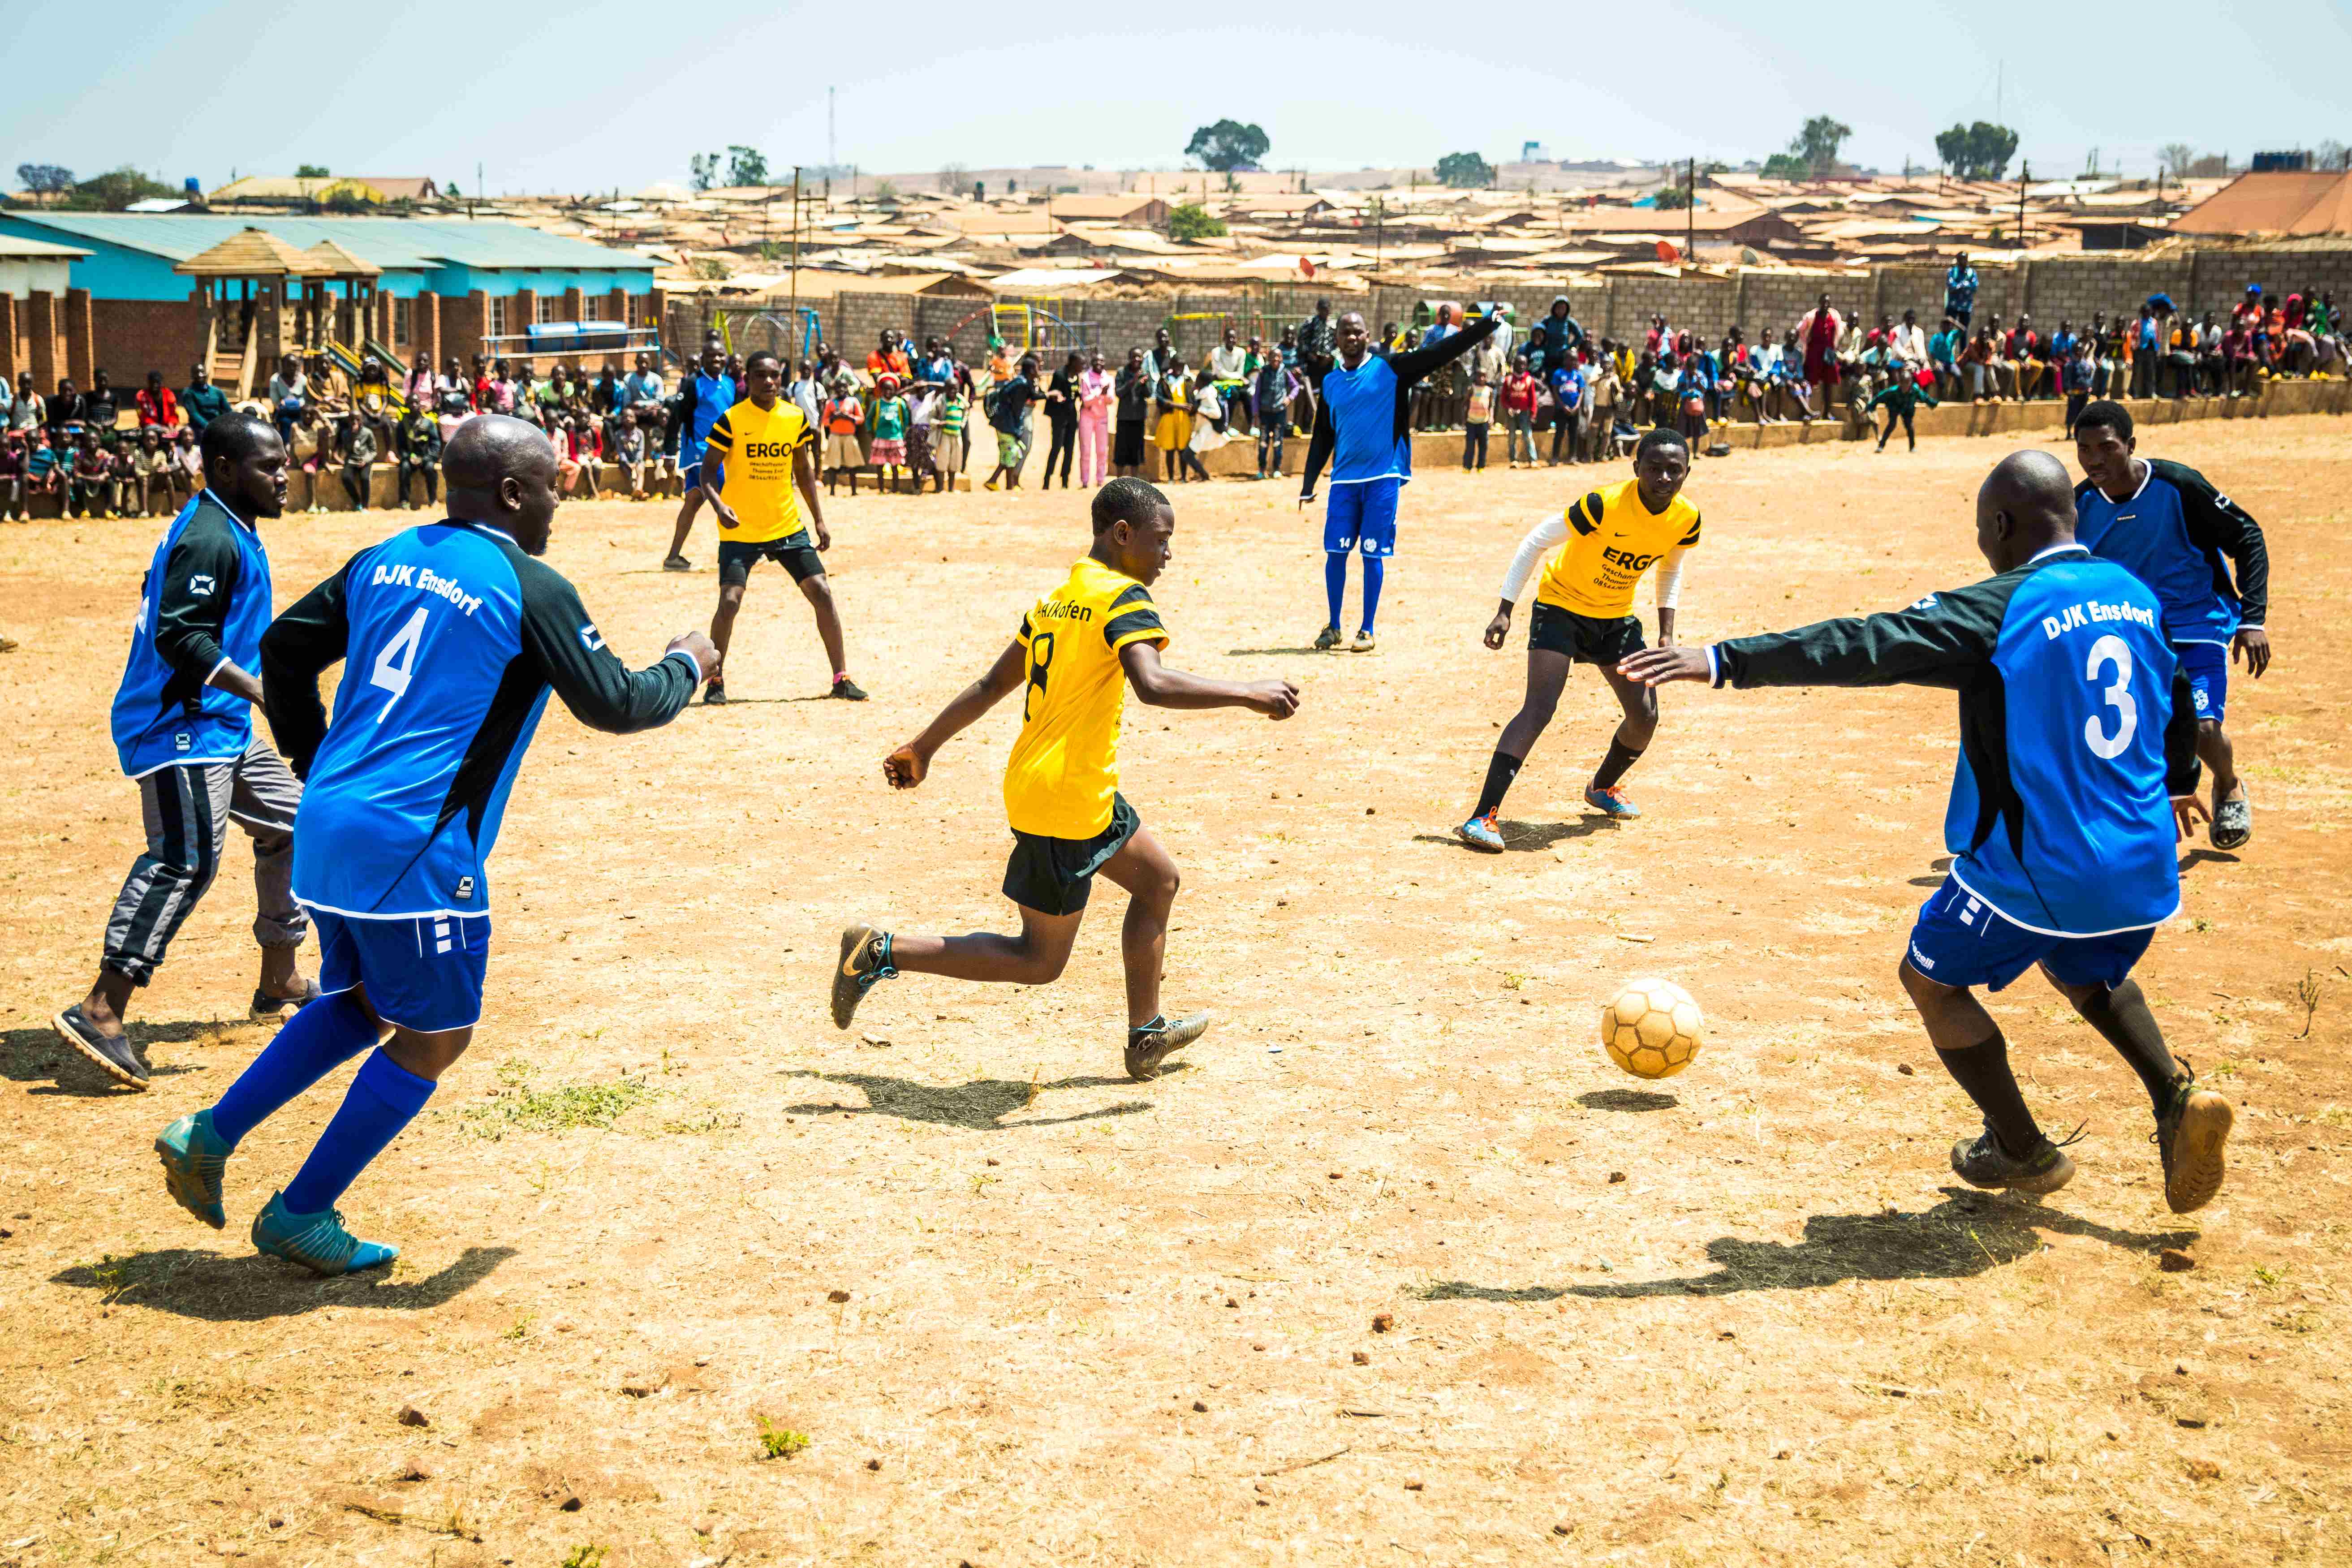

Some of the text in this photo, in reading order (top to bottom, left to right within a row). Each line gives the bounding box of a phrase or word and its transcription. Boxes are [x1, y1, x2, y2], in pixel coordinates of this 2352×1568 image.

[746, 443, 792, 457] ERGO
[1340, 537, 1350, 548] 14
[372, 564, 483, 617] DJK Ensdorf
[2042, 601, 2155, 641] DJK Ensdorf
[370, 607, 430, 724] 4
[1024, 632, 1054, 722] 8
[2085, 634, 2137, 760] 3
